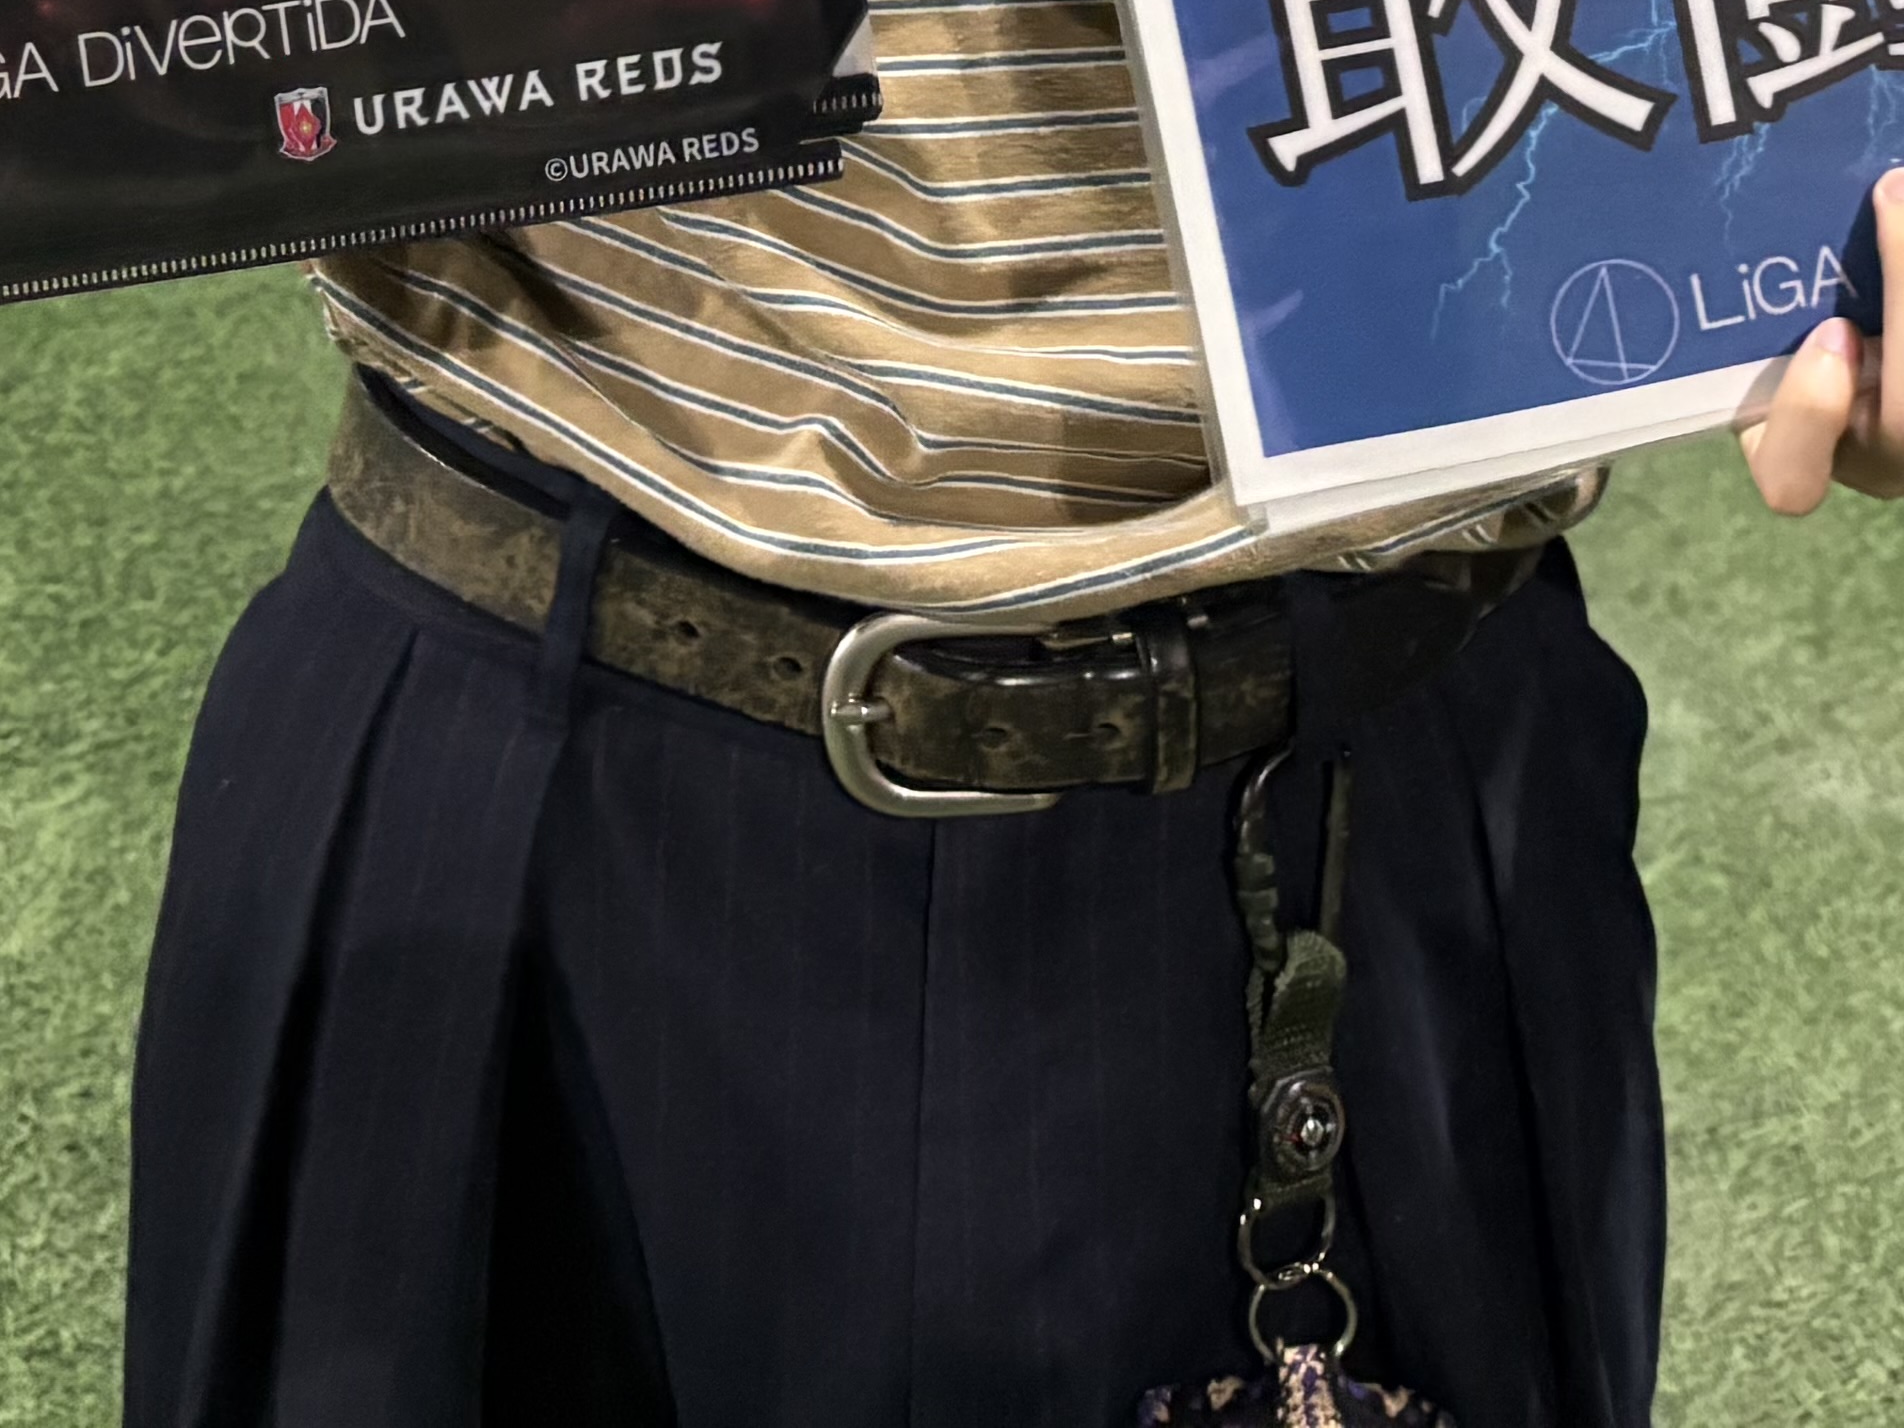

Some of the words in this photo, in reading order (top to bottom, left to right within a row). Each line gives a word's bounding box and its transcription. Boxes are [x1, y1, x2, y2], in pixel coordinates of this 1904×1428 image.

[354, 69, 554, 135] URAWA
[575, 42, 723, 101] REDS
[682, 127, 760, 163] REDS
